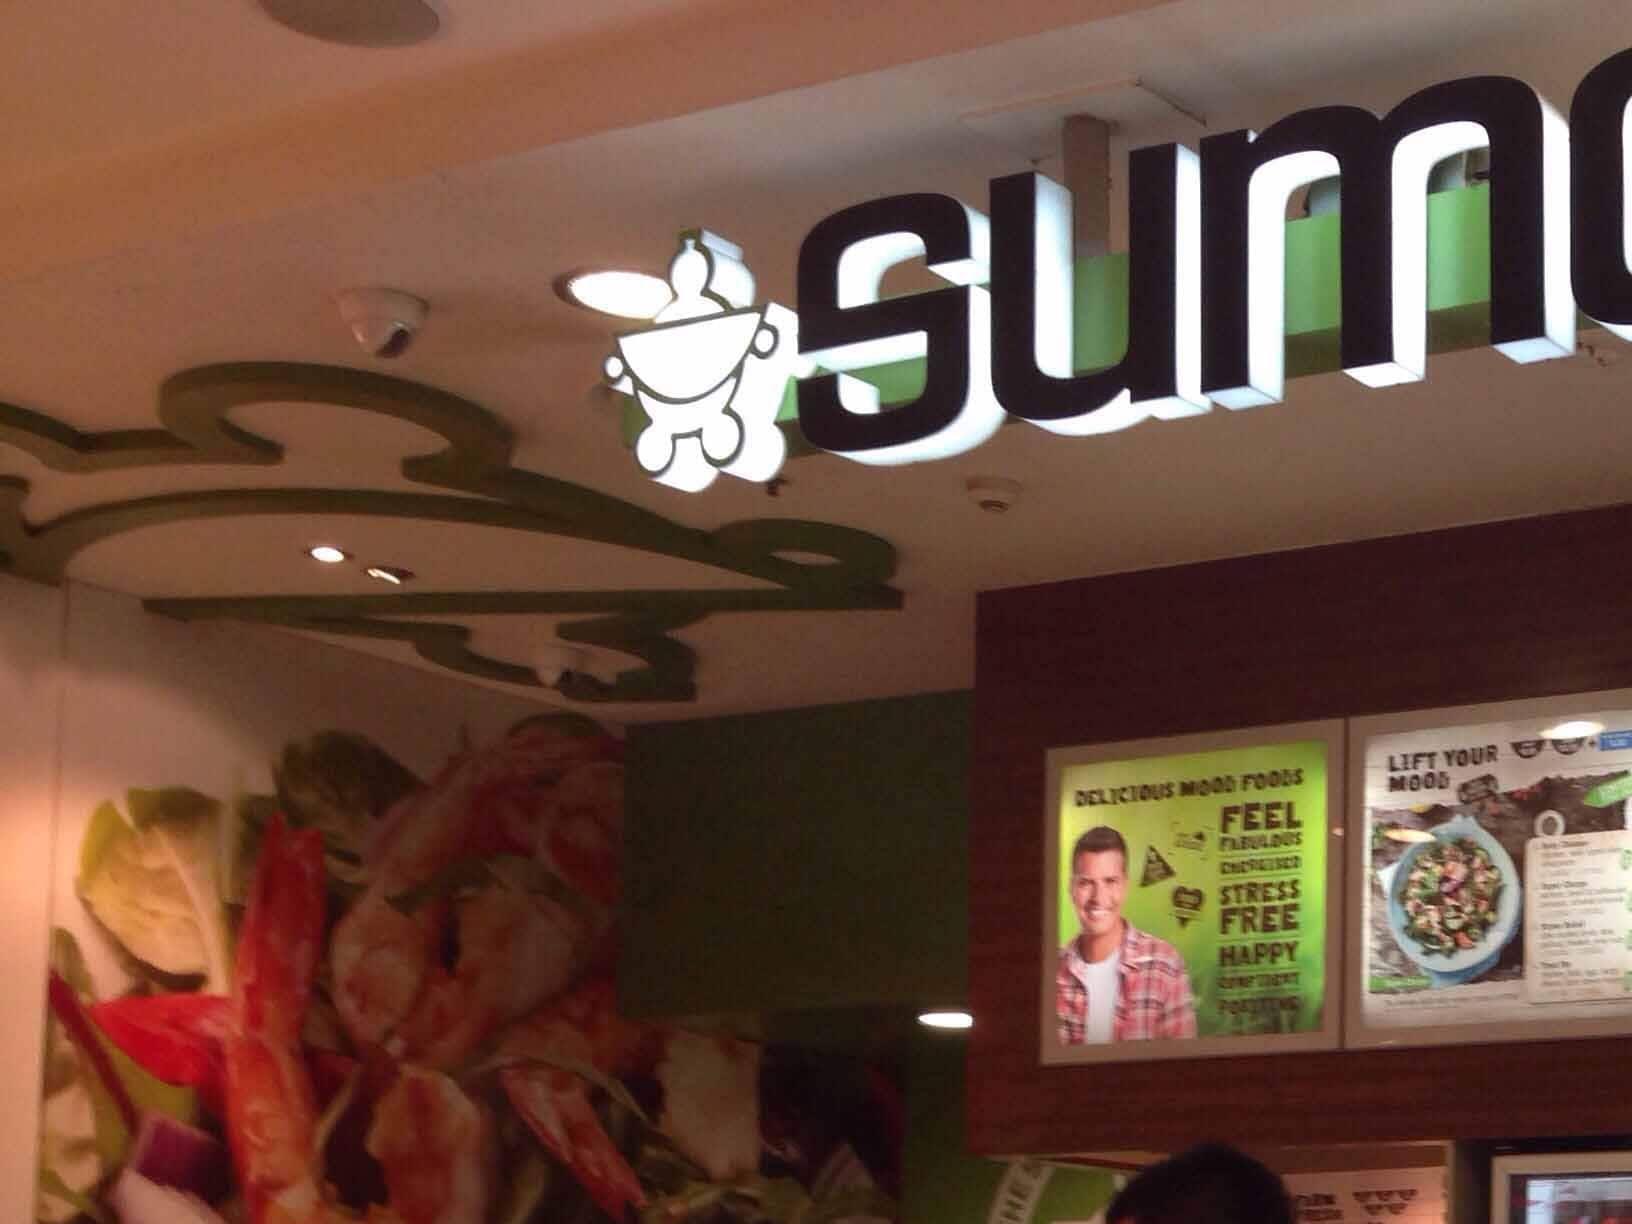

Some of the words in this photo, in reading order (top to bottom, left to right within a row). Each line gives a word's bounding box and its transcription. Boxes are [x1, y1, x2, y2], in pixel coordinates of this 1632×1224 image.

[1388, 751, 1437, 773] LIFT
[1443, 744, 1498, 768] YOUR
[1075, 782, 1174, 808] DELICIOUS
[1179, 775, 1236, 797] MOOD
[1241, 768, 1304, 790] FOODS
[1389, 771, 1450, 793] MOOD
[1220, 801, 1303, 834] FEEL
[1219, 878, 1301, 905] STRESS
[1218, 903, 1300, 935] FREE
[1218, 941, 1299, 967] HAPPY
